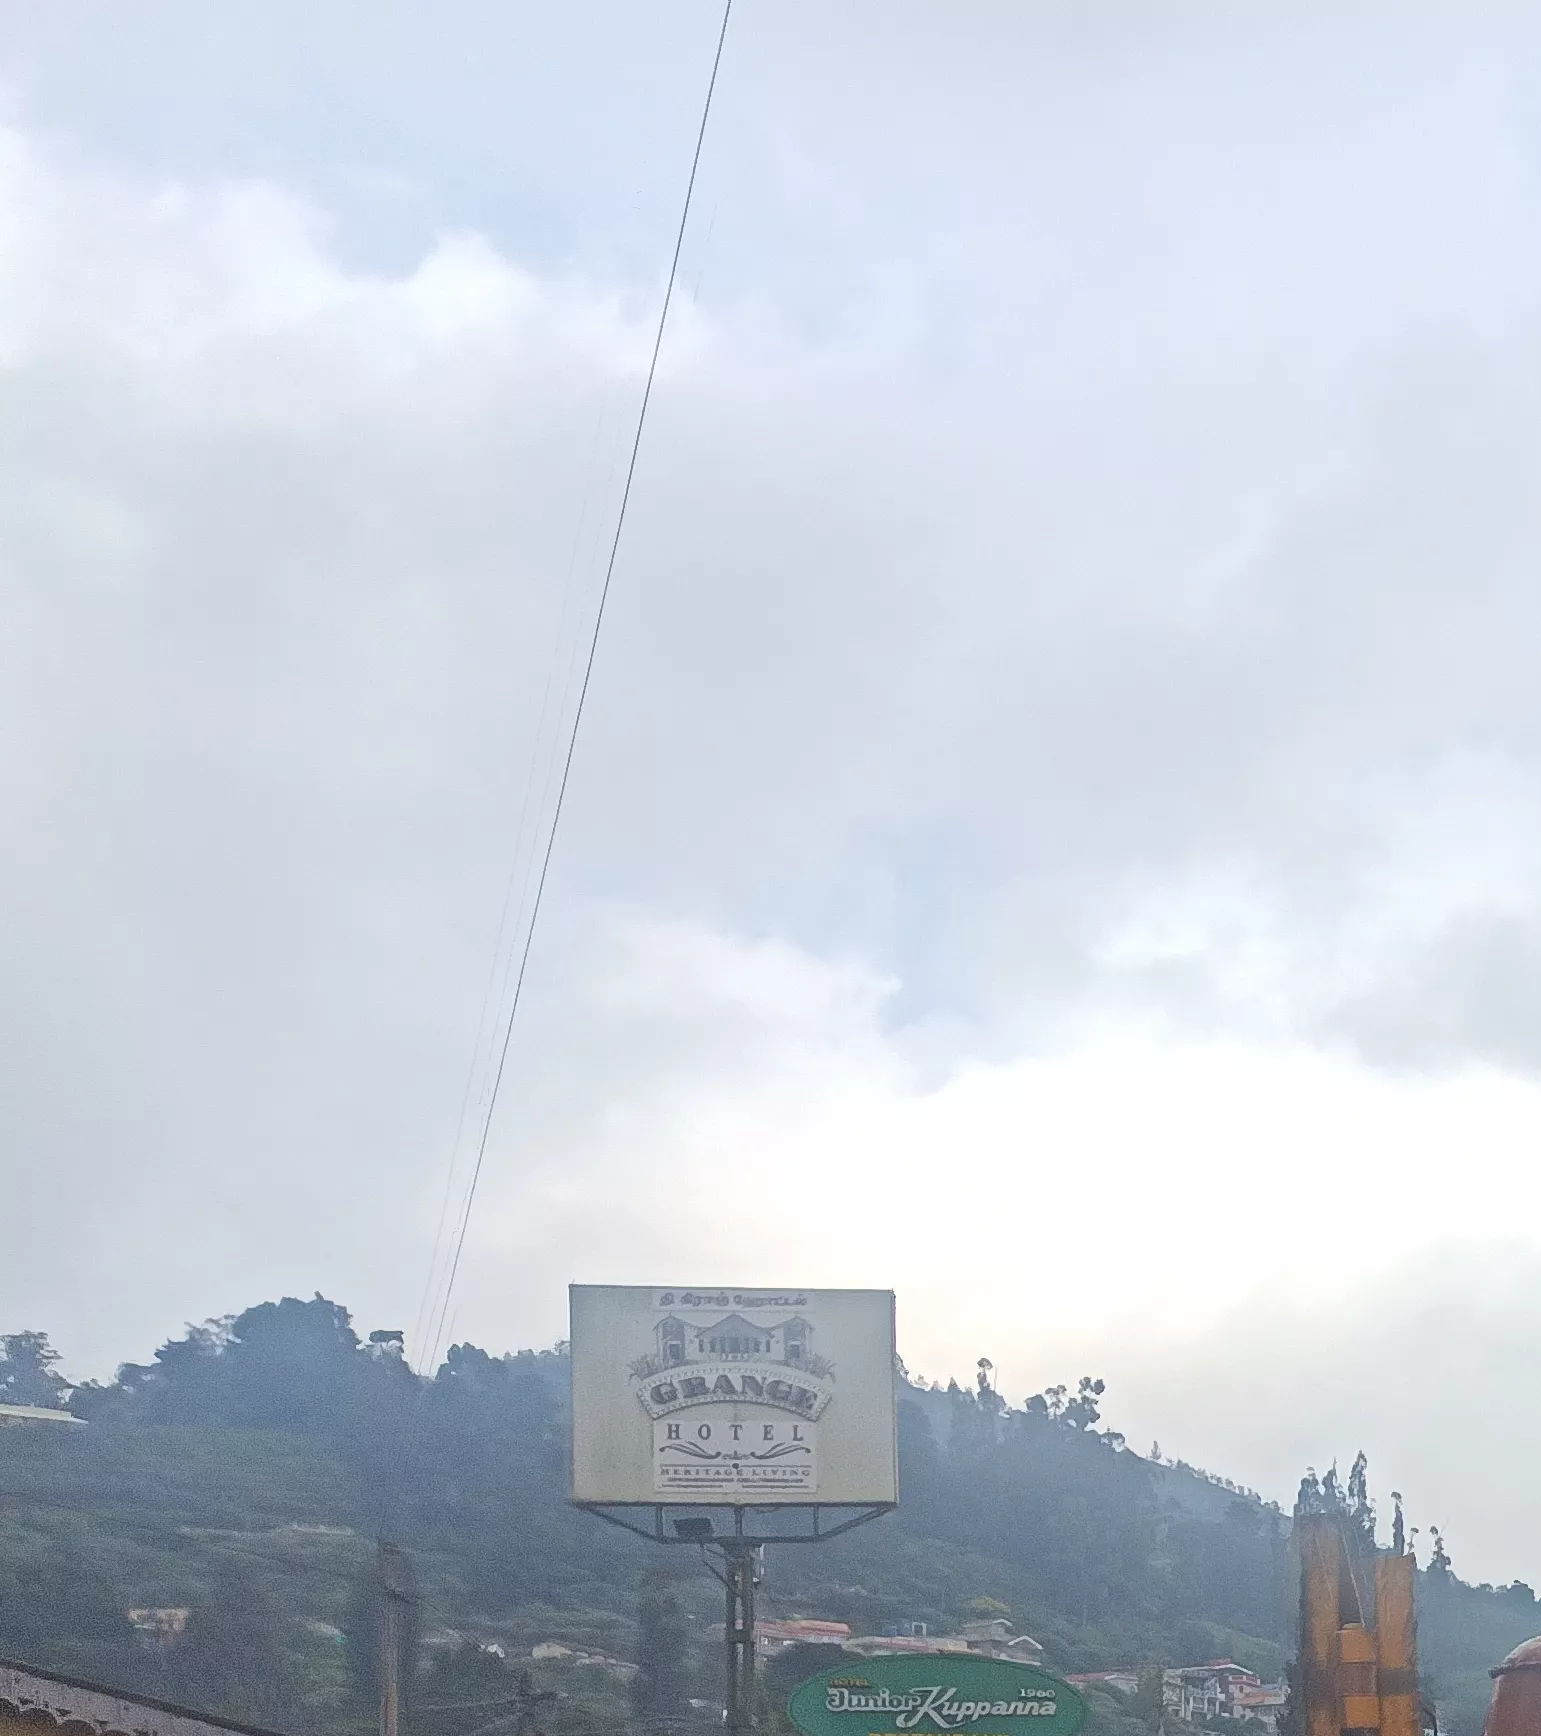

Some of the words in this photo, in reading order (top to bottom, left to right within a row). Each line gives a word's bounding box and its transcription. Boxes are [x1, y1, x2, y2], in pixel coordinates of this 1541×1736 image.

[667, 1423, 804, 1441] HOTEL
[752, 1468, 811, 1477] LIVING
[1019, 1688, 1055, 1698] 1960
[896, 1686, 1057, 1729] Kuppanna
